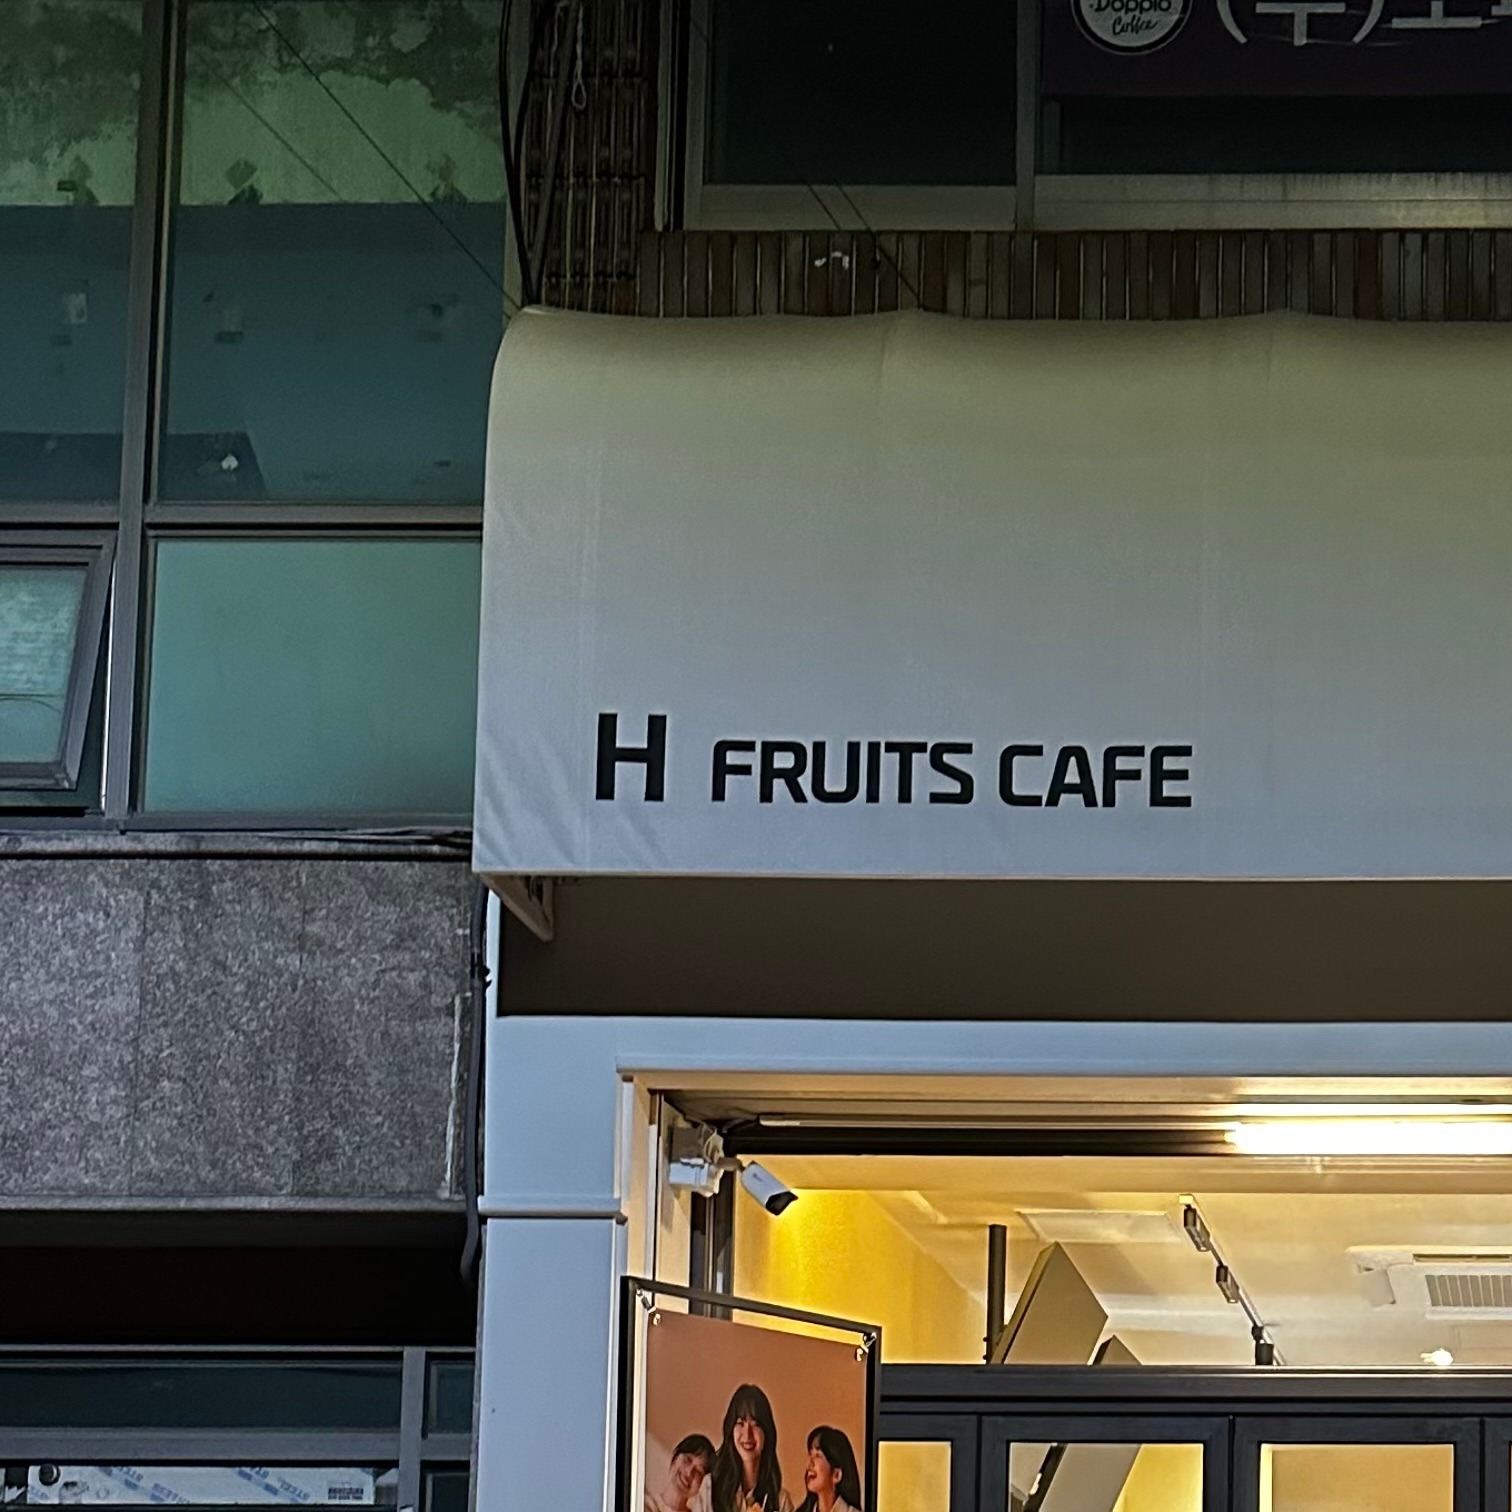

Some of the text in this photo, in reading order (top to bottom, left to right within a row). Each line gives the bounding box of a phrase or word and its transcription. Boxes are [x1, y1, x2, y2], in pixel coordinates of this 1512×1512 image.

[596, 712, 1192, 808] H FRUITS CAFE
